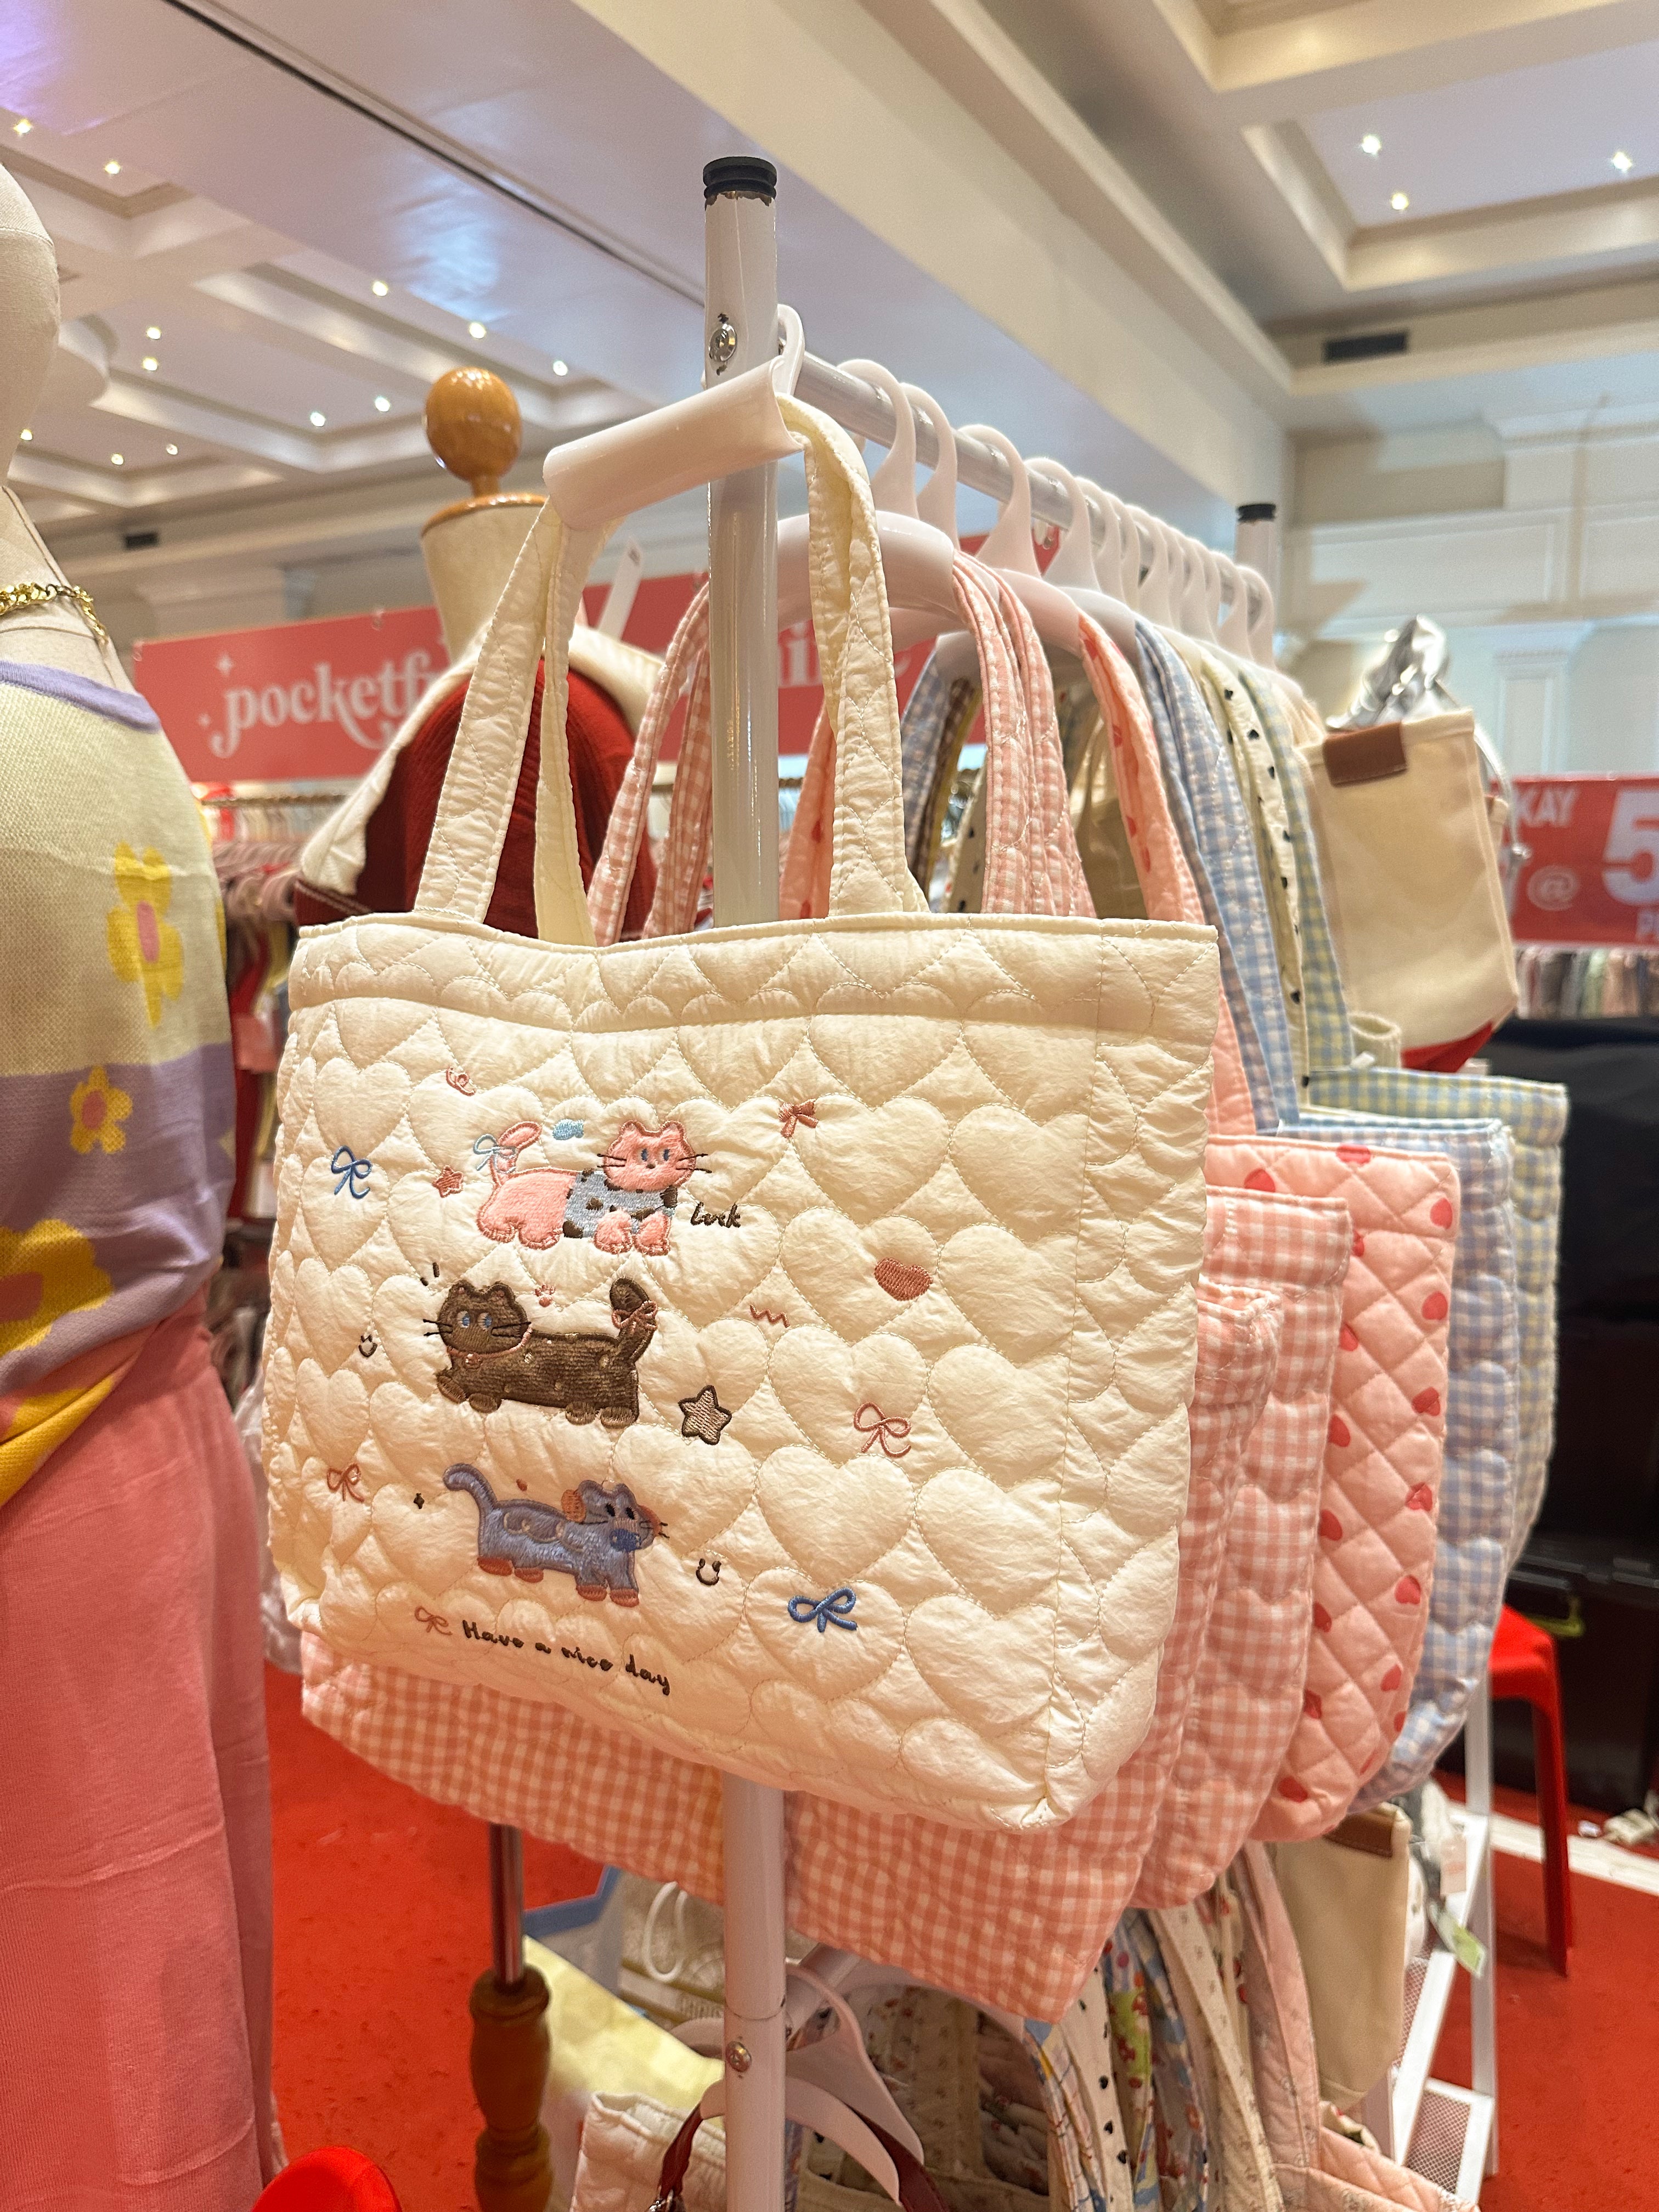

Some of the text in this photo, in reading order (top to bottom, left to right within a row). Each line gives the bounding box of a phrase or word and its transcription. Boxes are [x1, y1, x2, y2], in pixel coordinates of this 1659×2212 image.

[462, 1620, 670, 1695] Have a nice day
